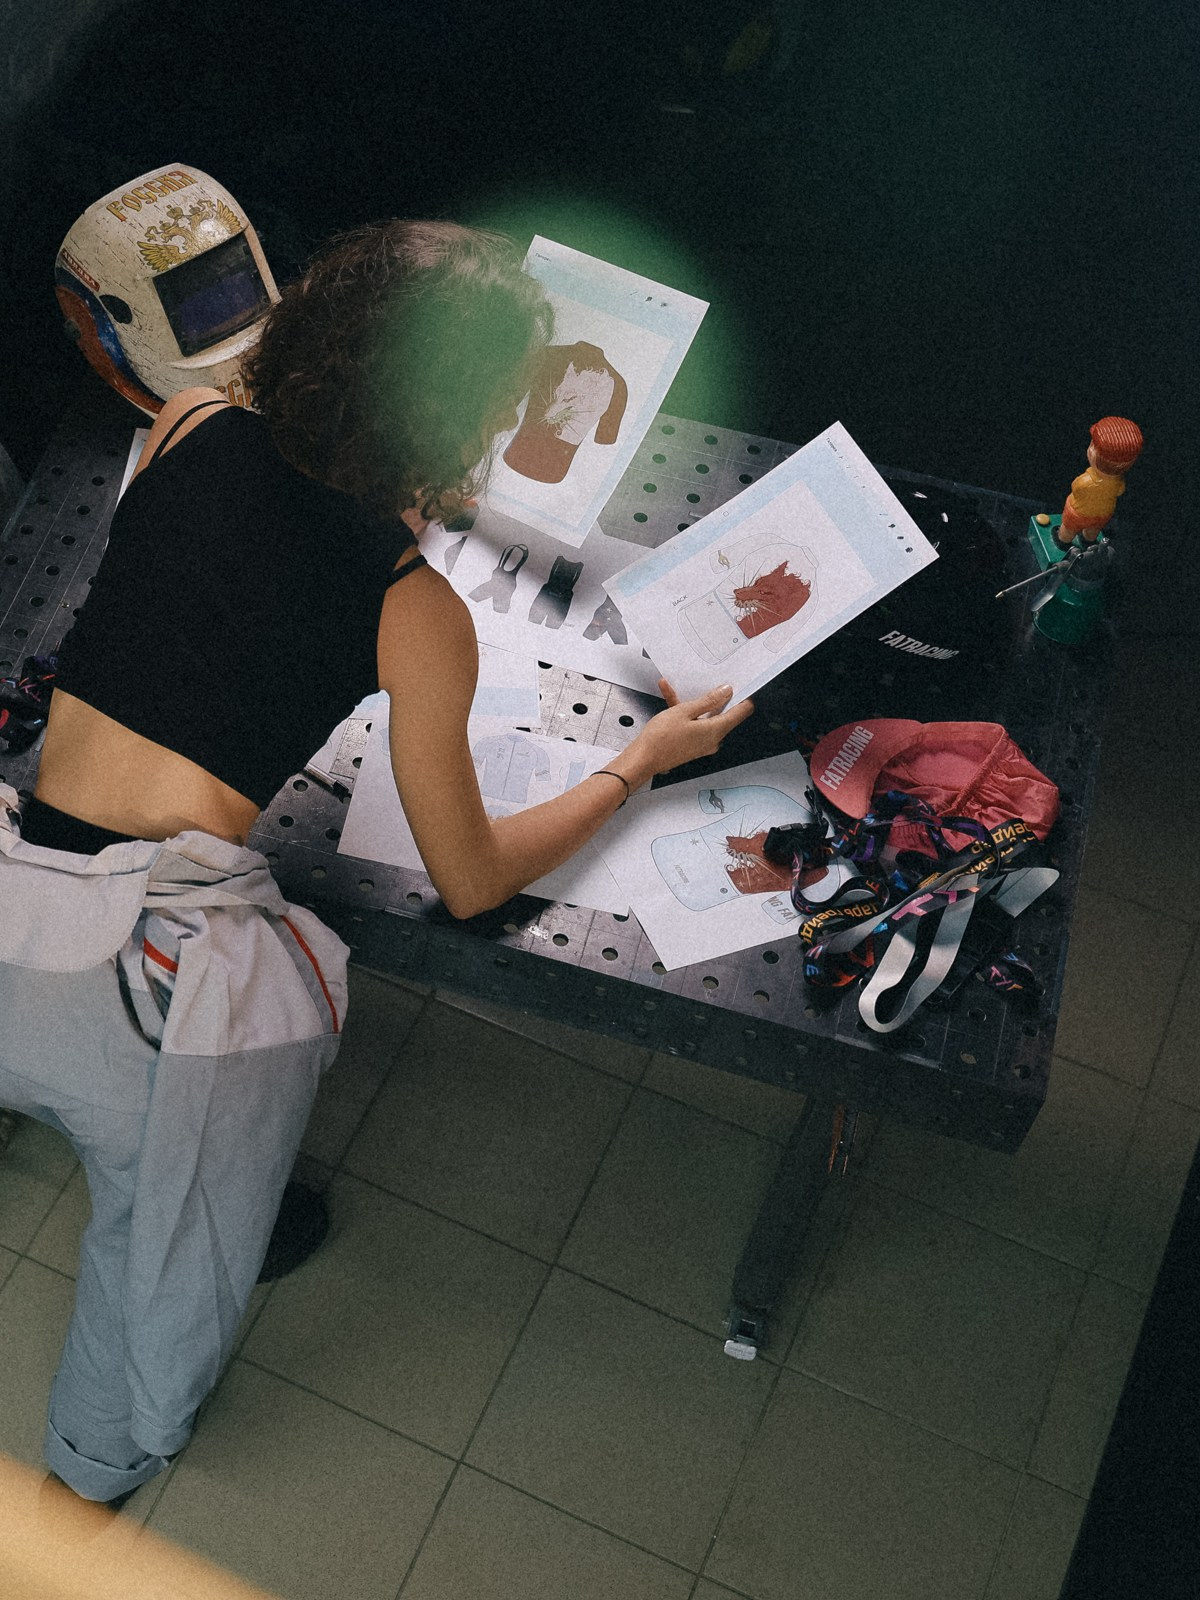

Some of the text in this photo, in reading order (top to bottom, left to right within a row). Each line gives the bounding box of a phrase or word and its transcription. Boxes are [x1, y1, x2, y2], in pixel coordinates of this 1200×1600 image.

[671, 594, 688, 607] BACK
[878, 630, 960, 660] FATRACING
[820, 725, 874, 791] FATRACING
